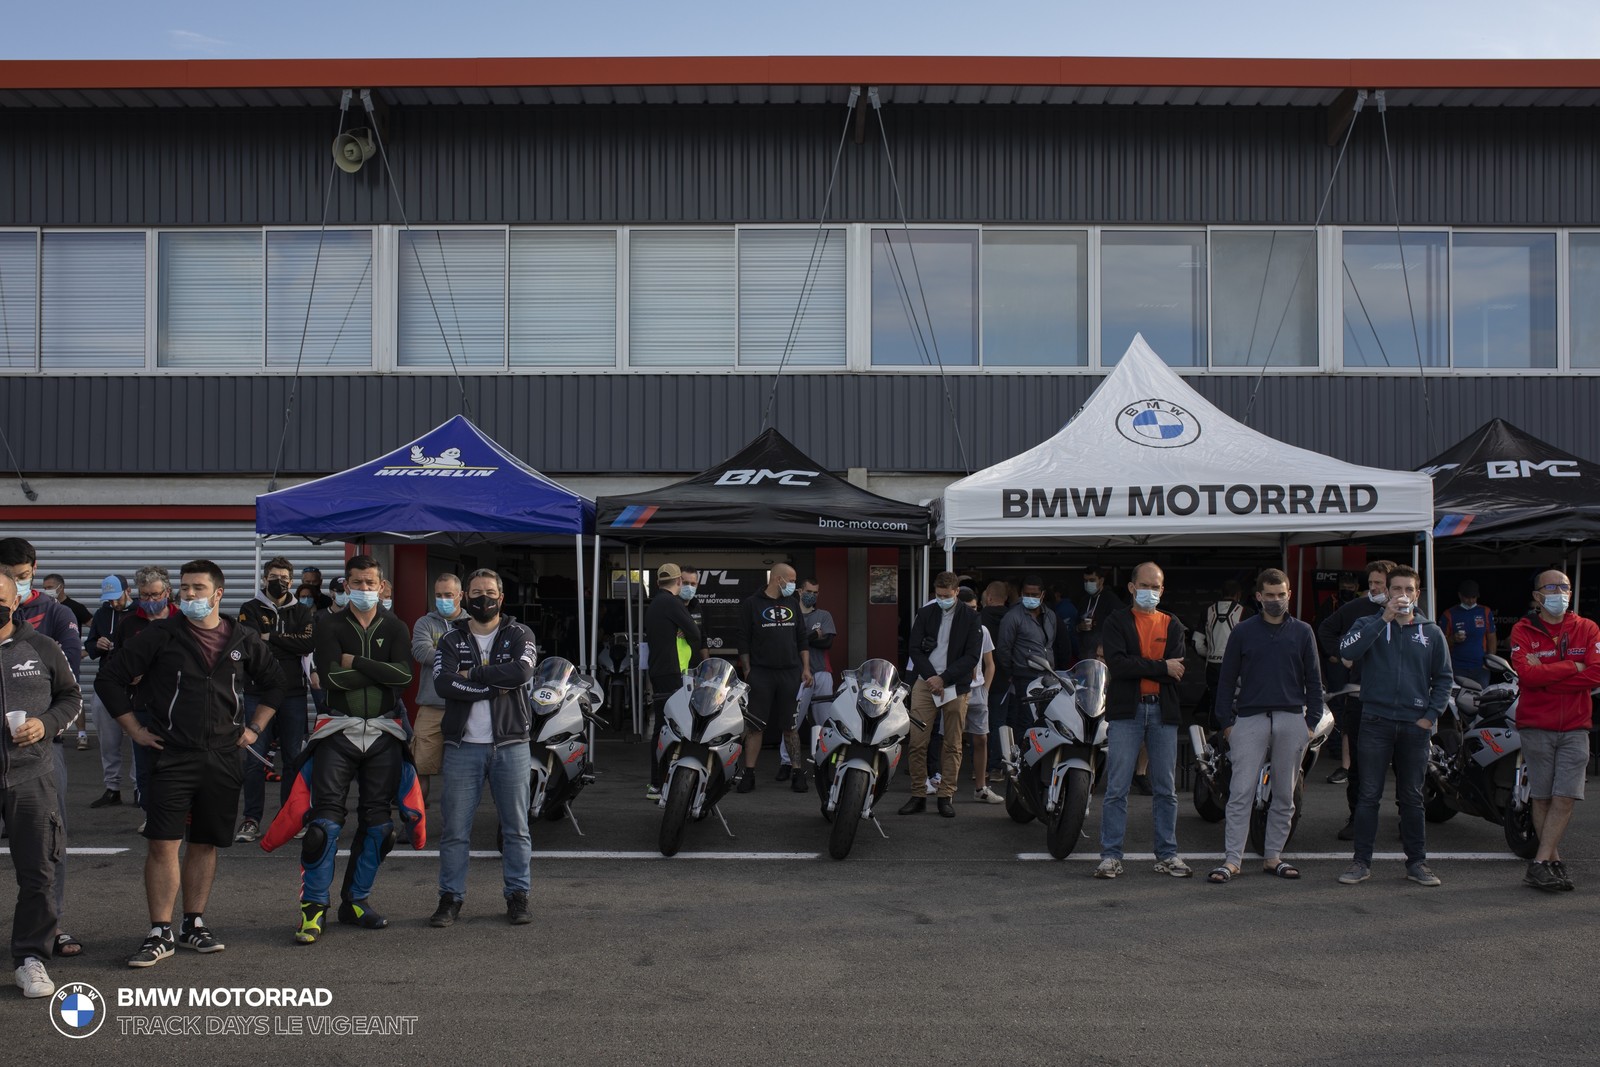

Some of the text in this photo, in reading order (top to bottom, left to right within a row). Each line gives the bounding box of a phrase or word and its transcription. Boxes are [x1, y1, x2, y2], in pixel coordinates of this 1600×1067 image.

[1124, 401, 1185, 417] BMW
[374, 469, 495, 477] MICHELIN
[1487, 460, 1581, 478] BMC
[714, 469, 820, 486] BMC
[1003, 484, 1378, 518] BMW MOTORRAD
[819, 517, 908, 531] bmc-moto.com
[12, 670, 41, 678] HOLLISTER
[539, 690, 552, 700] 56
[870, 689, 883, 698] 94
